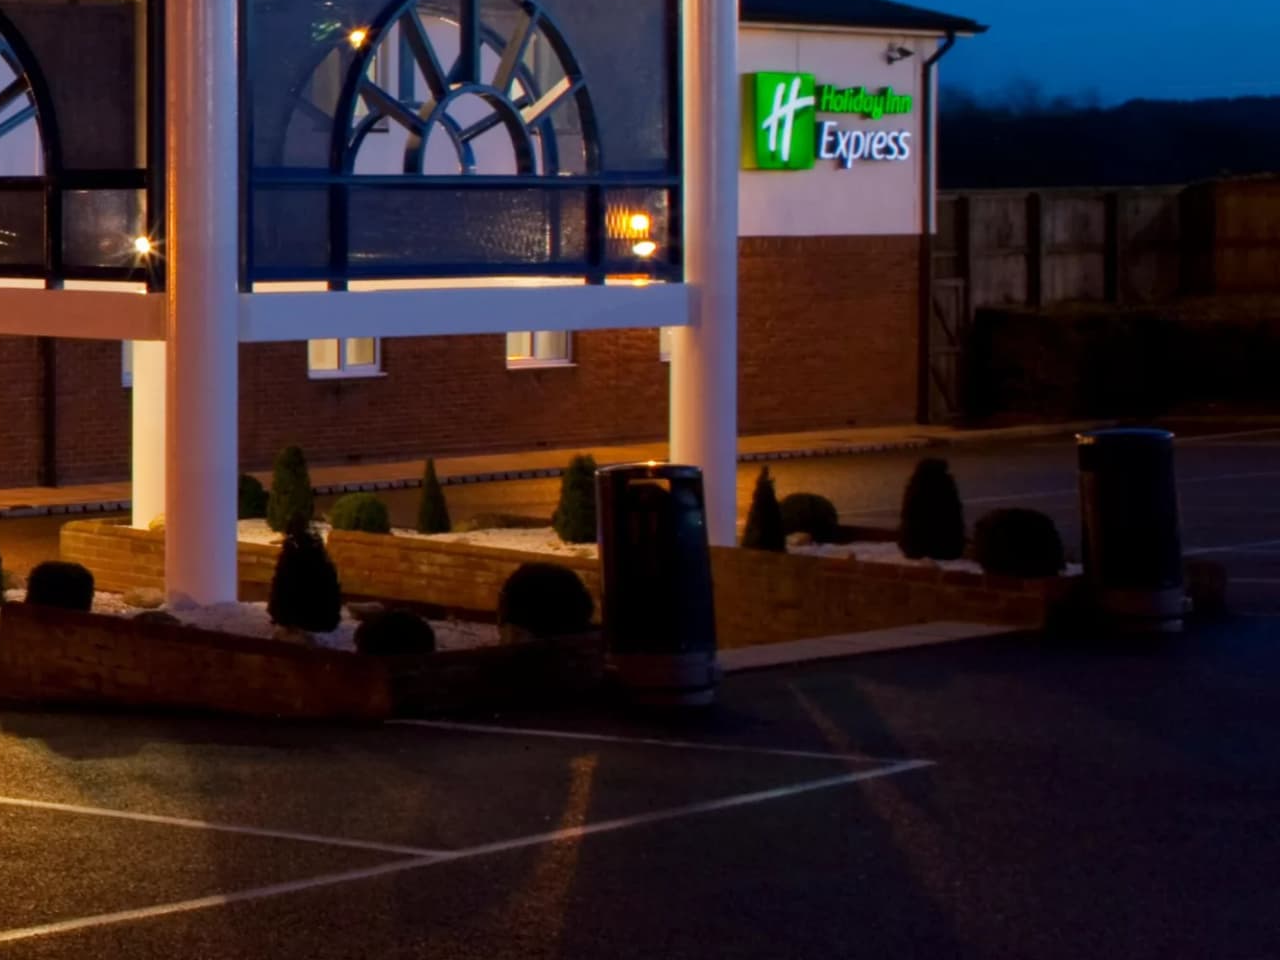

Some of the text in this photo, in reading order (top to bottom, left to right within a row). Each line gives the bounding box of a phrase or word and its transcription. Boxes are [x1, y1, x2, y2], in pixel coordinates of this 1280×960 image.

[821, 84, 912, 119] Holiday Inn
[820, 121, 911, 169] Express
